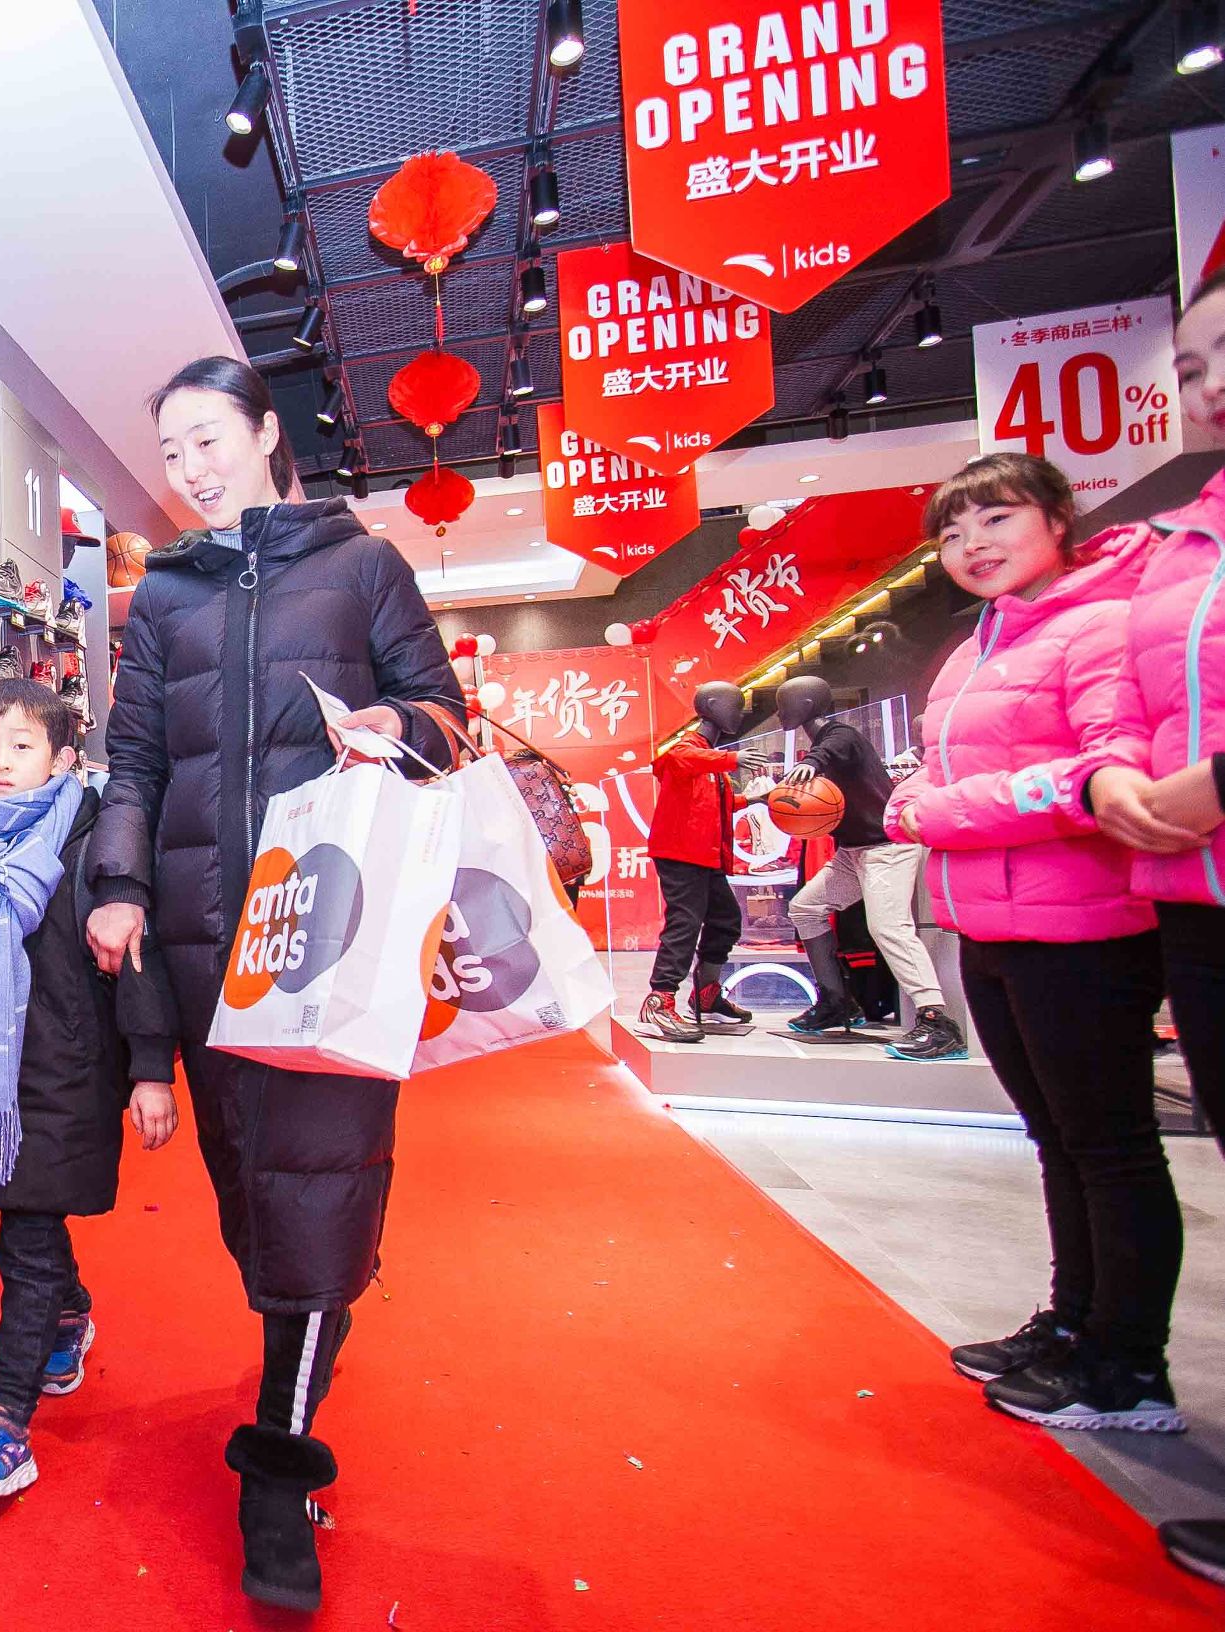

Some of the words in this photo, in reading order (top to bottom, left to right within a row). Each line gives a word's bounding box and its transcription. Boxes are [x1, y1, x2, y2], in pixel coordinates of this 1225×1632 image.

[664, 0, 888, 86] GRAND
[635, 43, 927, 149] OPENING
[686, 128, 879, 200] 盛大开业
[794, 242, 851, 270] kids
[568, 303, 760, 361] OPENING
[1011, 314, 1132, 347] 冬季商品三样
[601, 356, 729, 397] 盛大开业
[673, 431, 711, 449] kids
[1128, 412, 1169, 446] off
[546, 455, 690, 489] OPENI
[1070, 477, 1119, 492] akids
[24, 467, 41, 537] 11
[573, 487, 667, 517] 盛大开业
[627, 543, 655, 556] kids
[502, 670, 640, 739] 年货节
[247, 871, 319, 925] anta
[236, 922, 308, 976] kids
[429, 952, 493, 1001] ds
